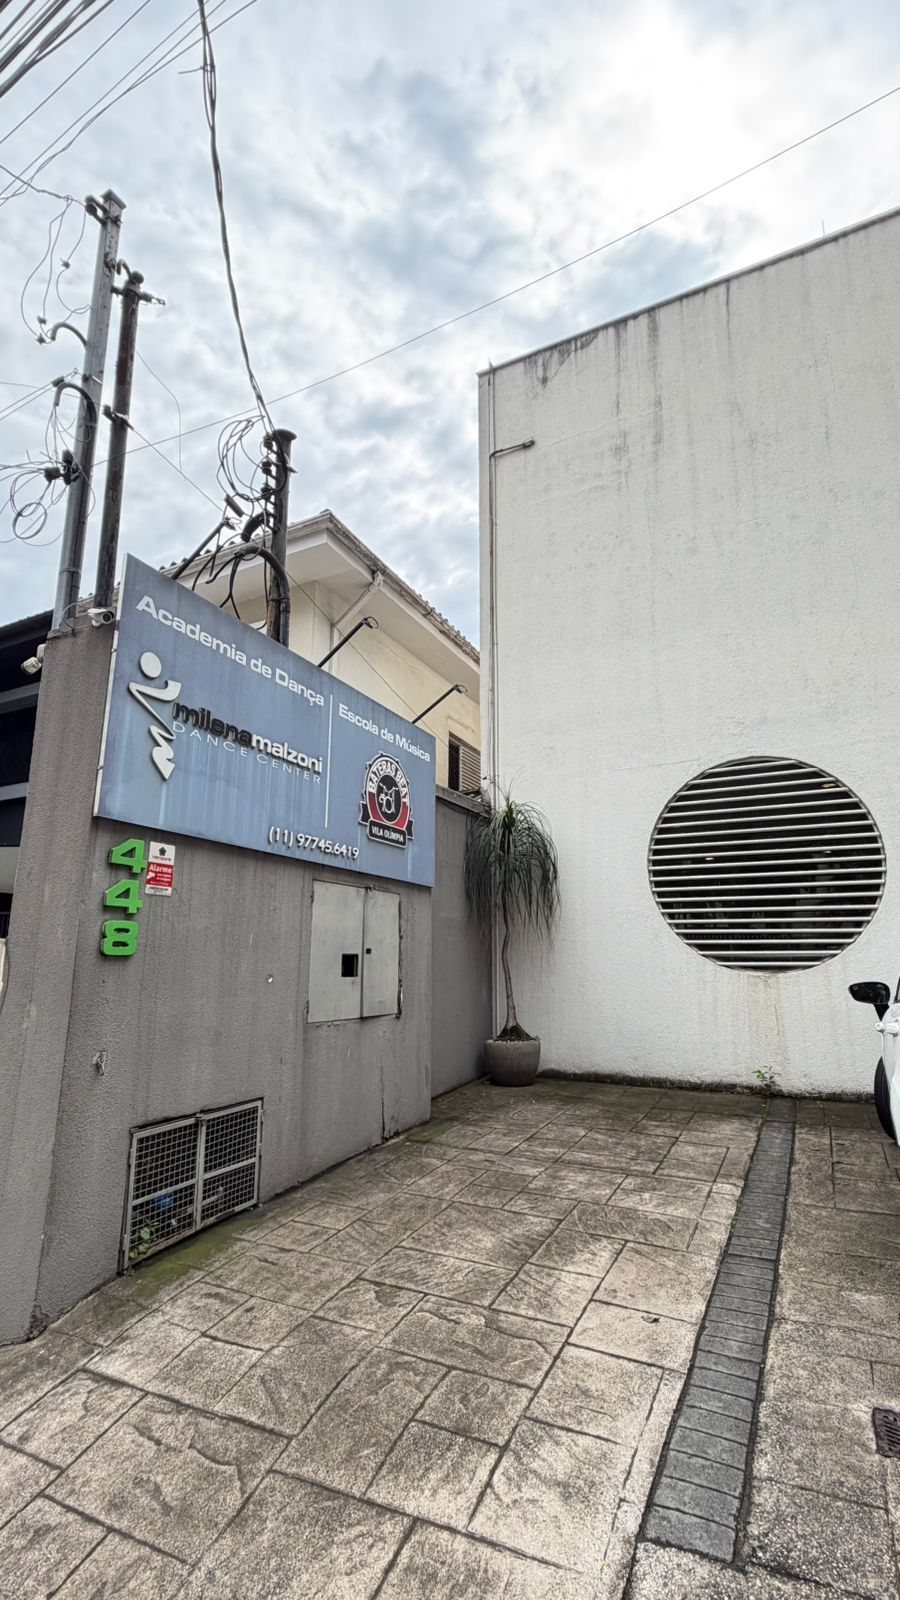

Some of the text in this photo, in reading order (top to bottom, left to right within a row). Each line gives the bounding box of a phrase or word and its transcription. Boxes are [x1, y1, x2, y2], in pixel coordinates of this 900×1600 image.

[136, 595, 325, 707] Academia de Dança
[339, 703, 432, 762] Escola de Música
[172, 721, 322, 785] DANCE CENTER
[368, 760, 397, 792] BATERAS
[269, 826, 360, 859] (11) 97745.6419
[371, 825, 405, 843] VILA OLÍMPIA
[149, 863, 172, 874] Alarme
